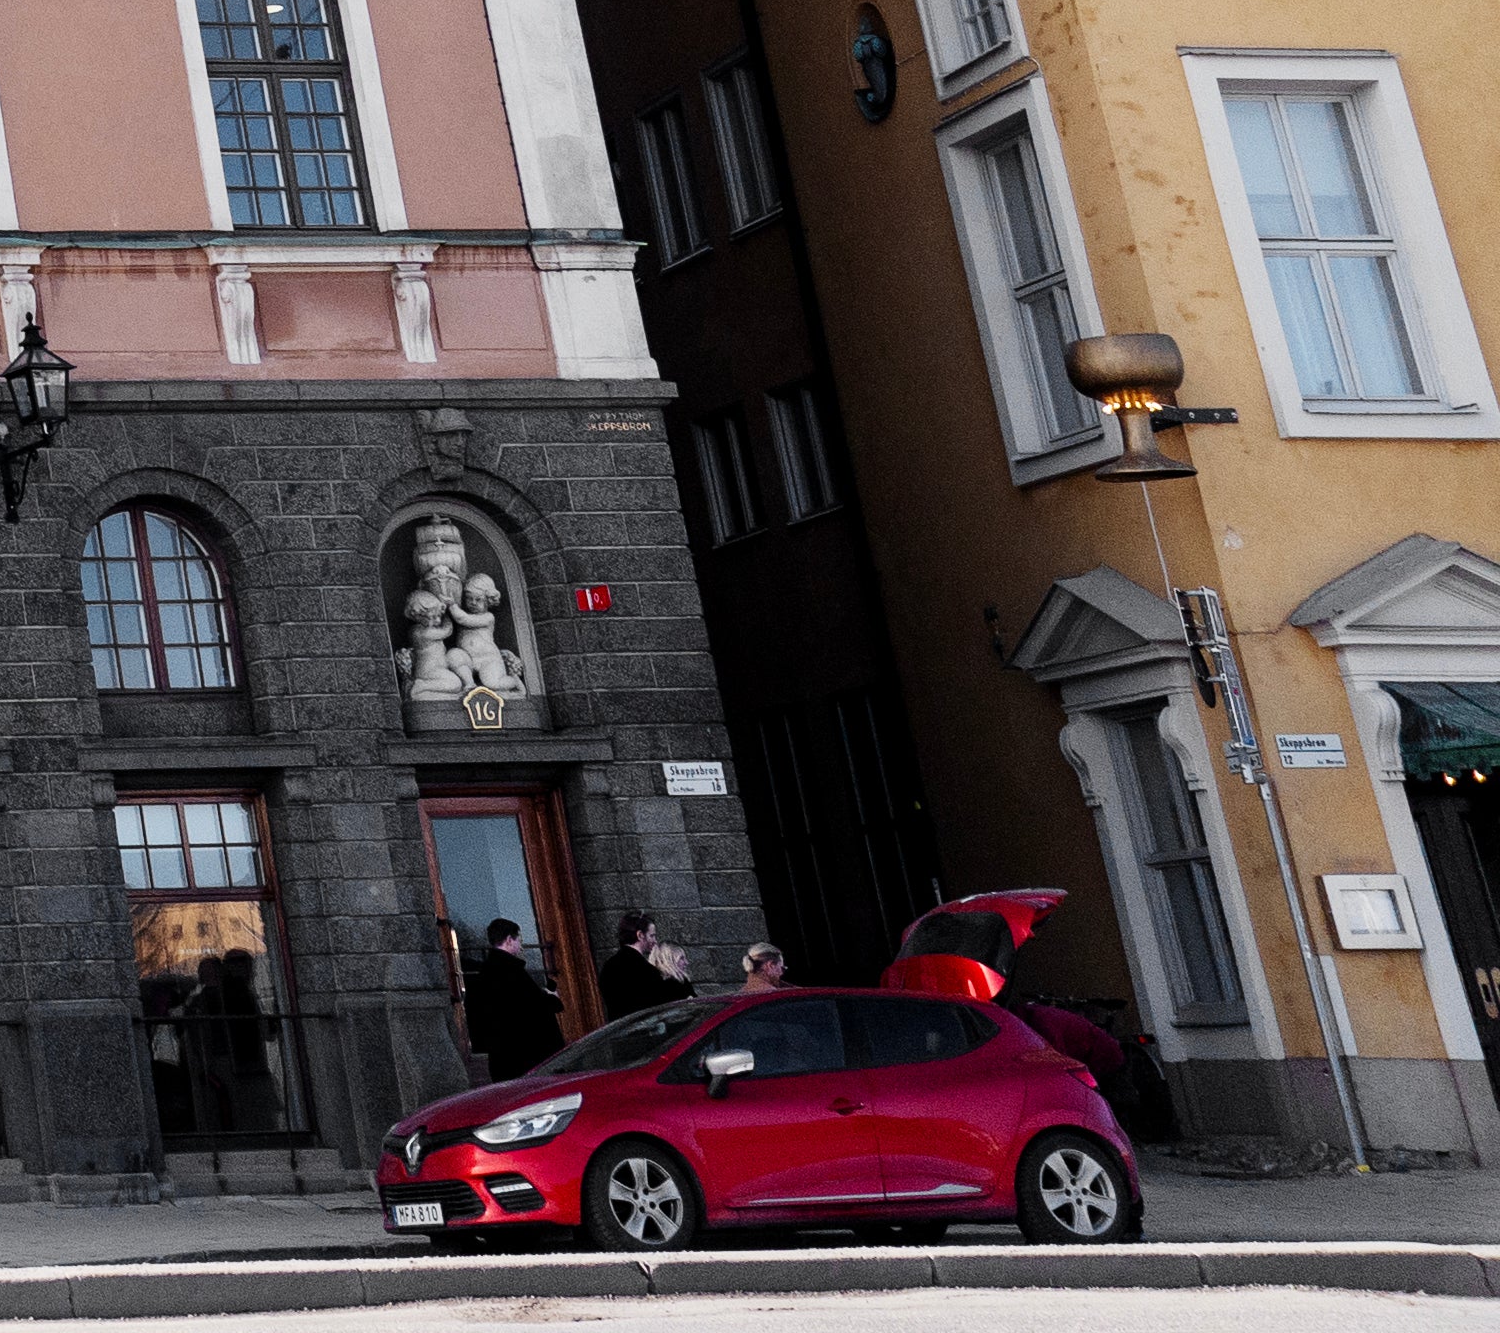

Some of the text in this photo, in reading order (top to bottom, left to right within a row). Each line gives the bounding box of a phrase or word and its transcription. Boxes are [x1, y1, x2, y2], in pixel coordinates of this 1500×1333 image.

[587, 422, 652, 431] SKEPPSBRON
[475, 701, 496, 721] 16
[1279, 737, 1326, 750] Skeppsbron
[1283, 755, 1294, 765] 12
[670, 765, 719, 778] Skeppsbron
[398, 1205, 439, 1223] MFA 810
